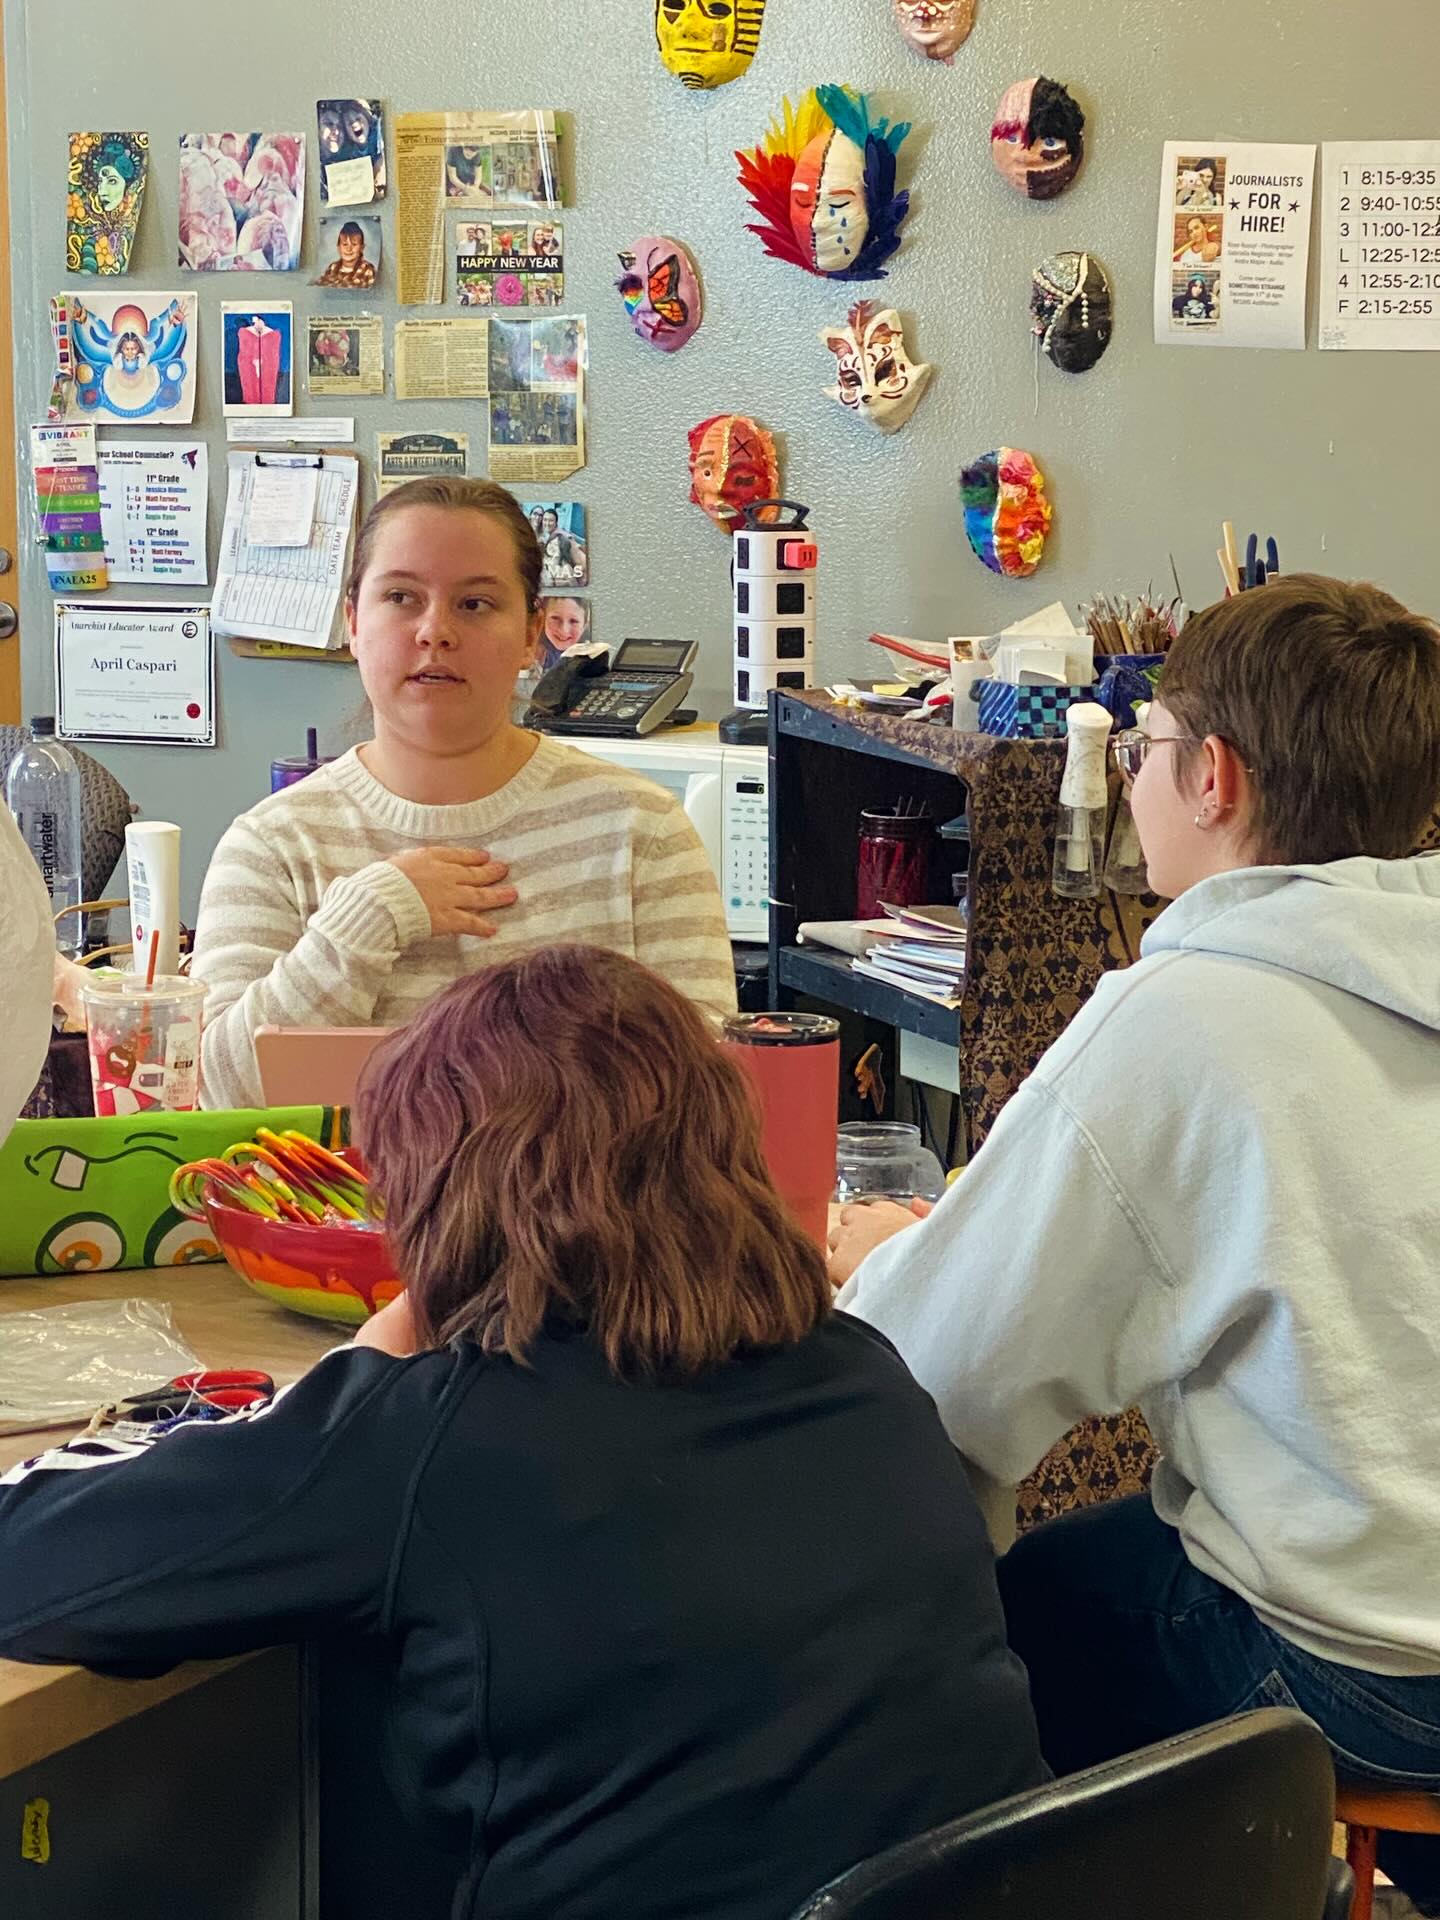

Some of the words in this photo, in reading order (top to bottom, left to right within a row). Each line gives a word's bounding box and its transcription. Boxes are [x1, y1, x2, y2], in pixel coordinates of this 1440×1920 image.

[1228, 174, 1304, 187] JOURNALISTS
[1342, 171, 1349, 185] 1
[1361, 170, 1436, 185] 8:15-9:35
[1248, 192, 1281, 210] FOR
[1340, 196, 1350, 211] 2
[1240, 216, 1285, 232] HIRE!
[1340, 222, 1350, 237] 3
[1340, 248, 1350, 262] L
[461, 257, 498, 268] HAPPY
[500, 257, 527, 268] NEW
[529, 258, 558, 268] YEAR
[1338, 274, 1348, 288] 4
[1338, 300, 1349, 314] F
[1358, 300, 1432, 314] 2:15-2:55
[112, 450, 134, 458] School
[158, 474, 180, 484] Grade
[338, 480, 352, 517] SCHEDULE
[158, 528, 178, 537] Grade
[332, 531, 344, 551] TEAM
[329, 551, 340, 575] DATA
[71, 621, 106, 631] Anarchist
[108, 622, 145, 632] Educator
[148, 624, 175, 633] Award
[90, 657, 122, 672] April
[126, 658, 177, 674] Caspari
